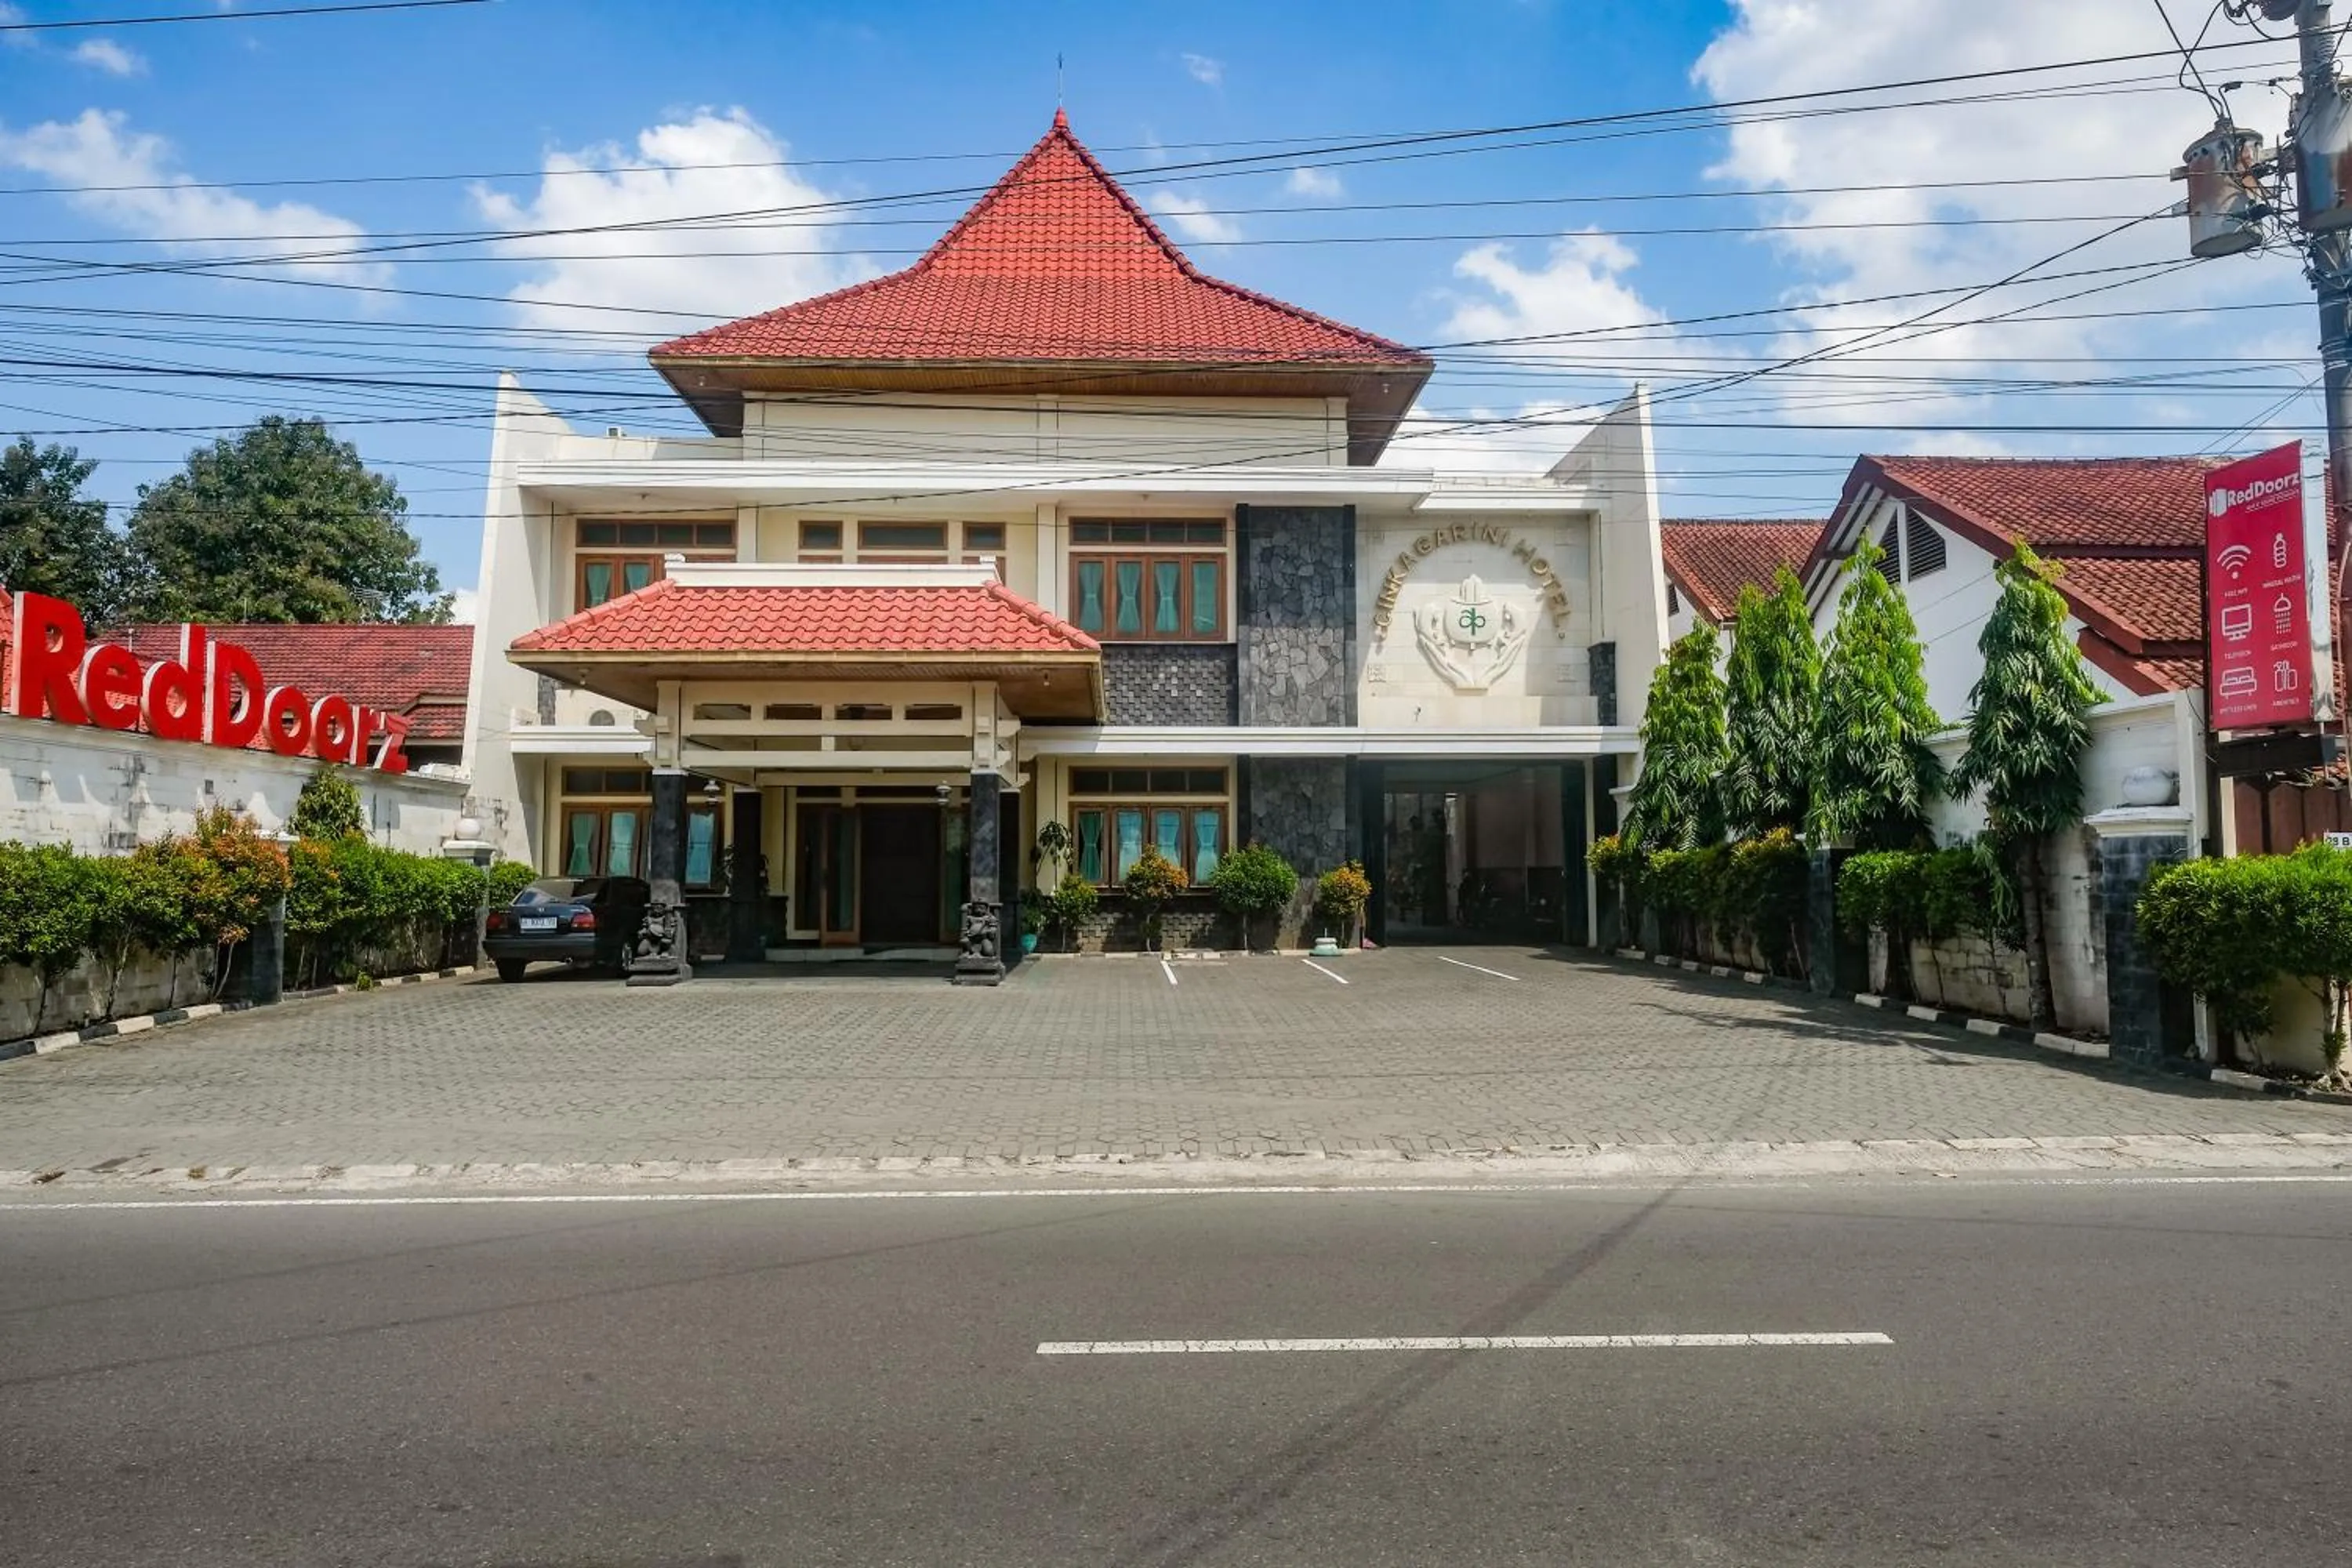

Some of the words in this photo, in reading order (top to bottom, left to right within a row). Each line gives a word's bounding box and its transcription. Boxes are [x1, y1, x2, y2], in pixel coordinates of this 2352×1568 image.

[2227, 473, 2300, 507] RedDoorz
[1512, 539, 1571, 628] HOTEL
[11, 591, 409, 775] RedDoorz
